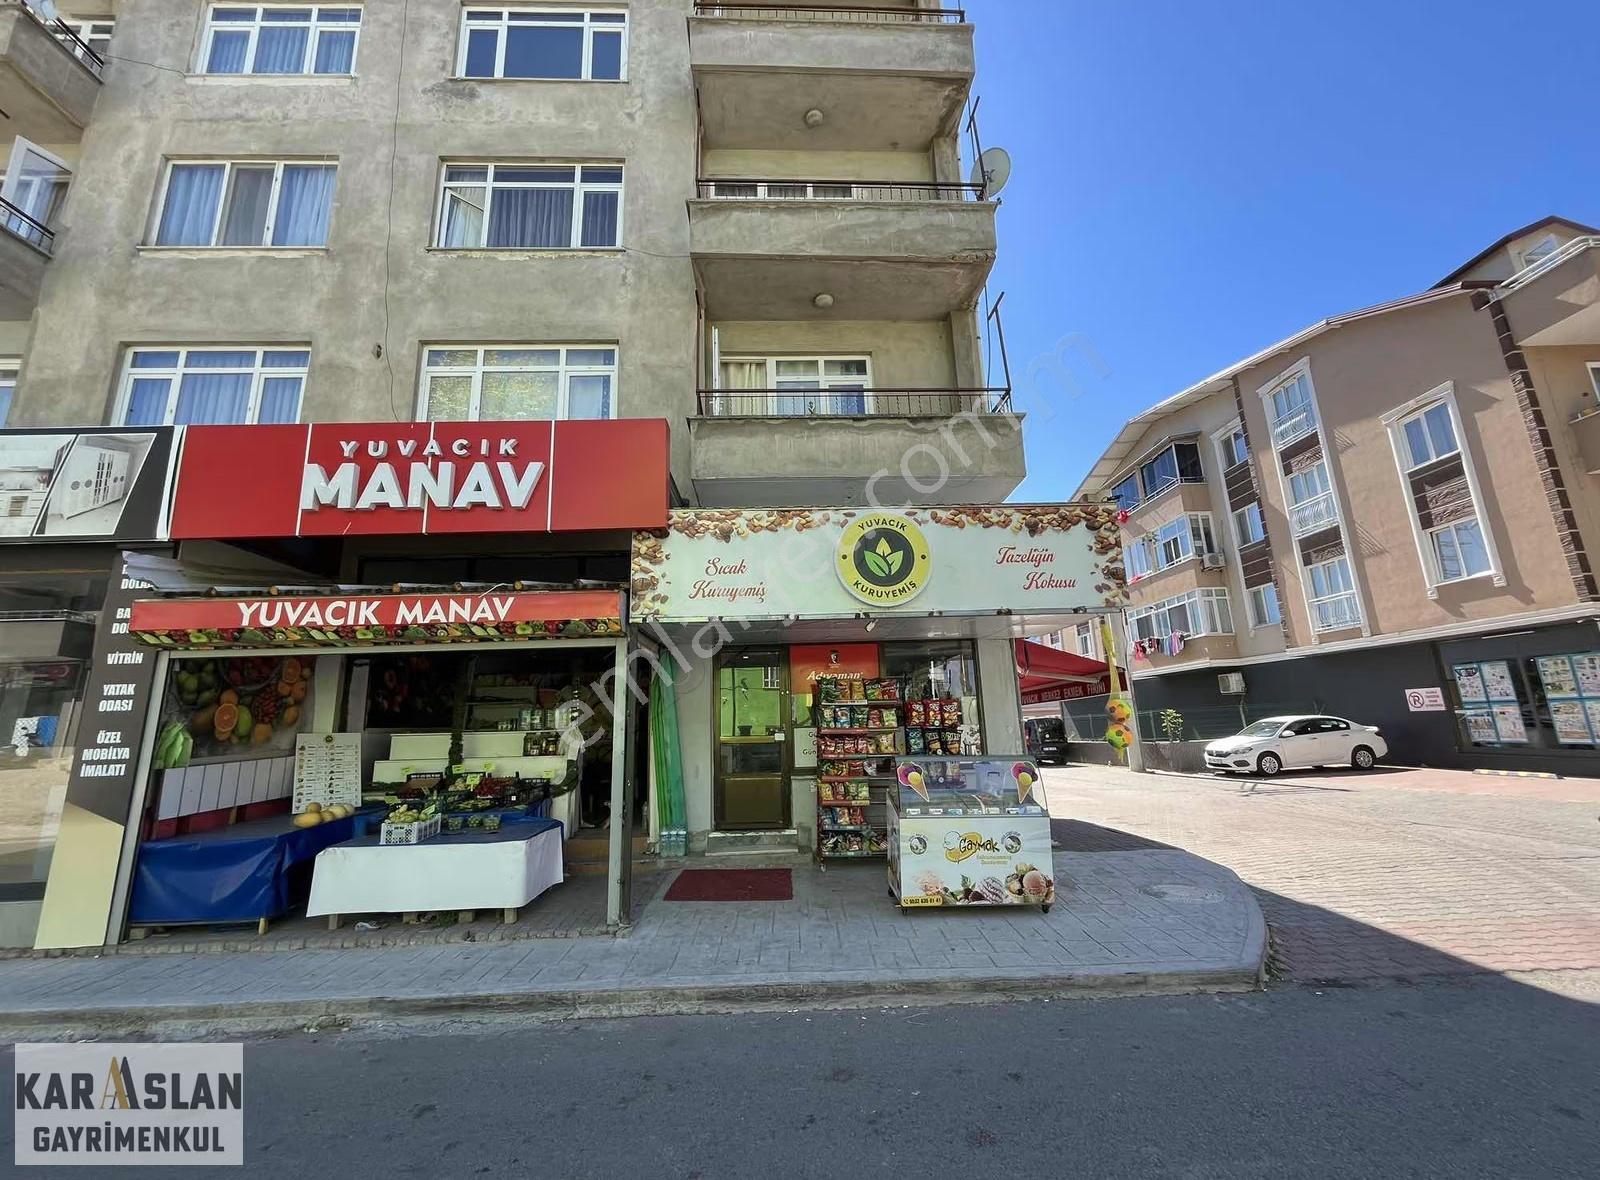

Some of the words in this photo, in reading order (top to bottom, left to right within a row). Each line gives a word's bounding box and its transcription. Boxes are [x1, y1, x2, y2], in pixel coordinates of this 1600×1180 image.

[339, 438, 519, 458] YUVACIK
[301, 461, 546, 511] MANAV
[858, 518, 908, 532] YUVACIK
[705, 557, 748, 577] Sıcak
[1023, 571, 1078, 591] Kokusu
[688, 579, 766, 603] Kuruyemiş
[853, 579, 918, 599] KURUYEMİŞ
[237, 600, 382, 627] YUVACIK
[394, 597, 515, 626] MANAV
[107, 651, 144, 665] VİTRİN
[103, 684, 136, 696] YATAK
[1063, 685, 1084, 698] EKMEK
[99, 699, 133, 712] ODASI
[96, 730, 121, 744] ÖZEL
[81, 747, 130, 761] MOBİLYA
[80, 763, 126, 778] İMALATI
